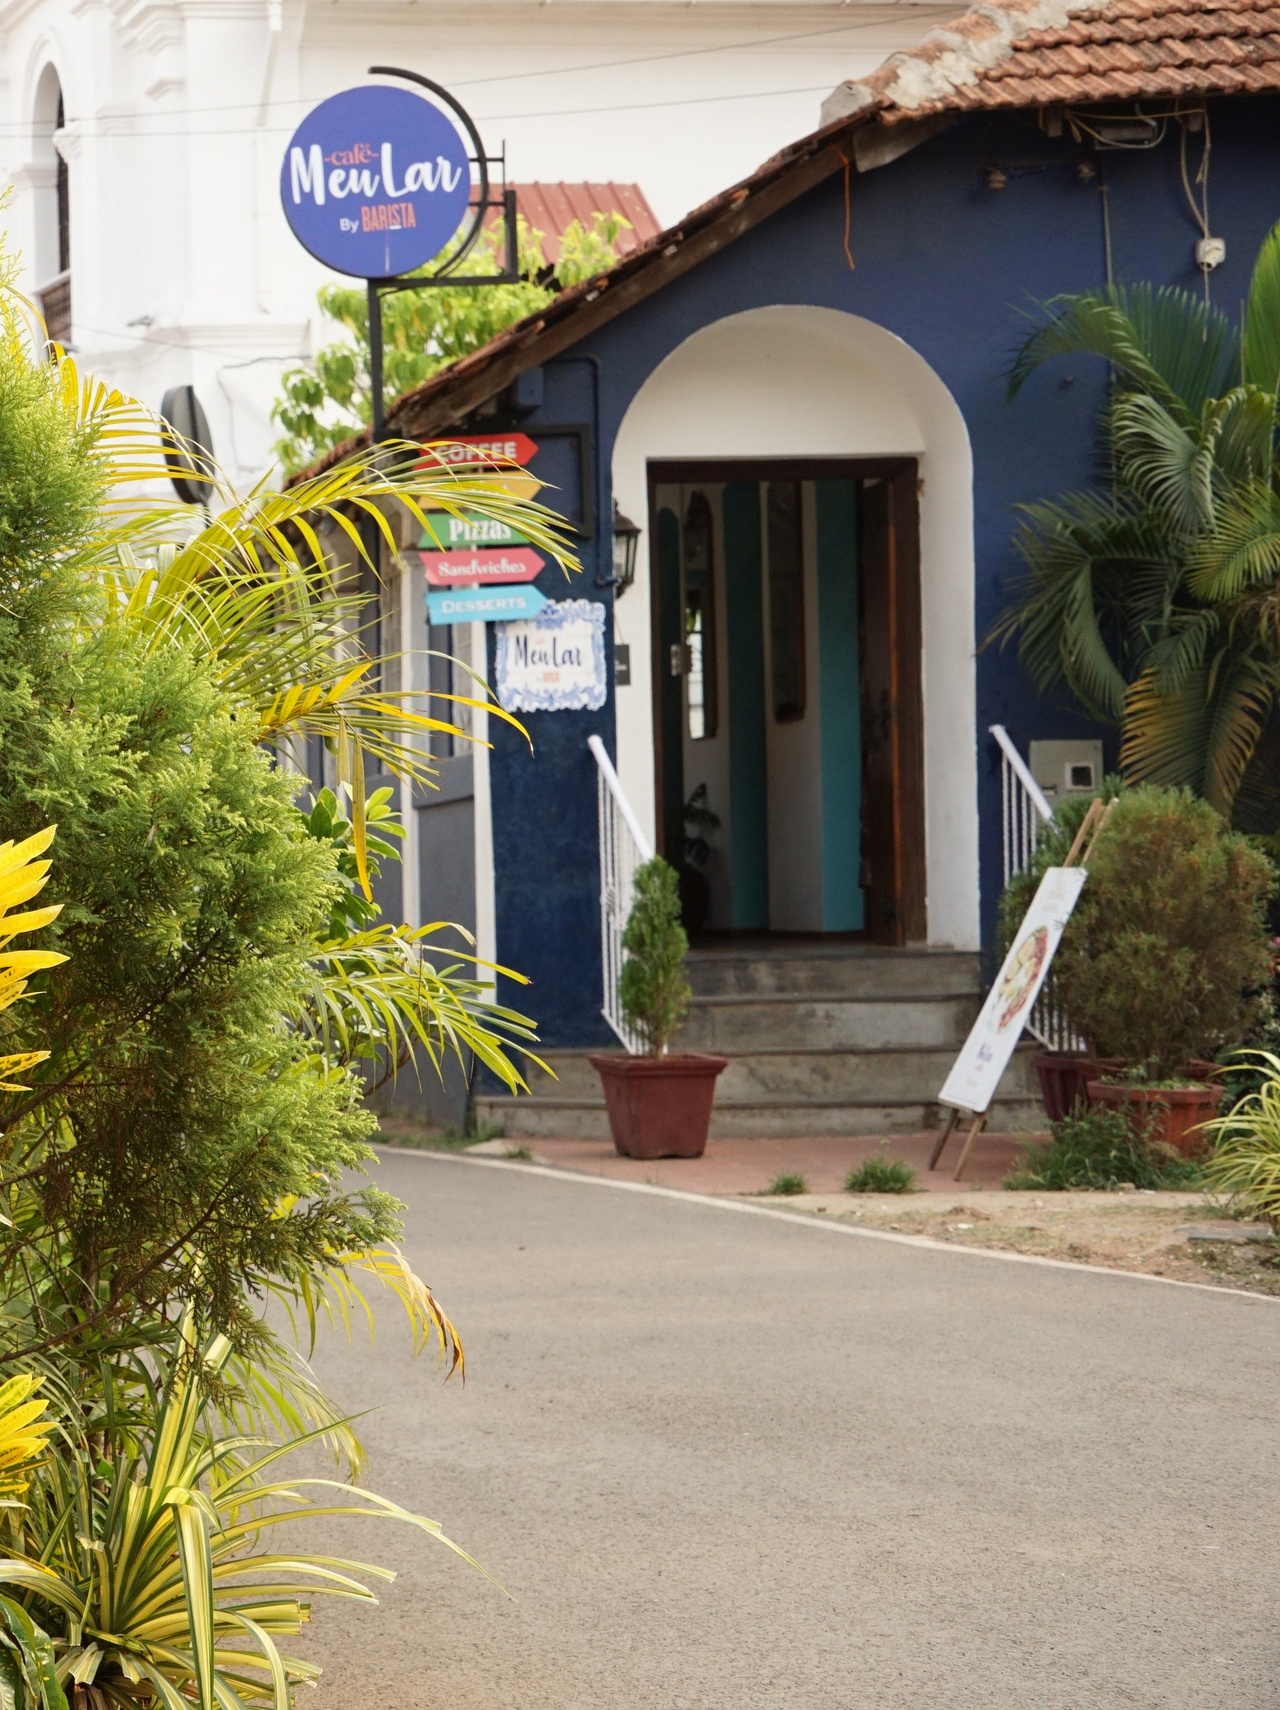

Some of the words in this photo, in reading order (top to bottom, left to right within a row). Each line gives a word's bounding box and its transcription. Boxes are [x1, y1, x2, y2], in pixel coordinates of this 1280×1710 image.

[290, 143, 380, 205] Meu
[381, 142, 463, 198] Lar
[339, 217, 359, 234] By
[361, 202, 417, 232] BARISTA
[449, 518, 512, 541] Pizzas
[438, 557, 527, 577] Sandwiches
[442, 597, 527, 614] DESSERTS
